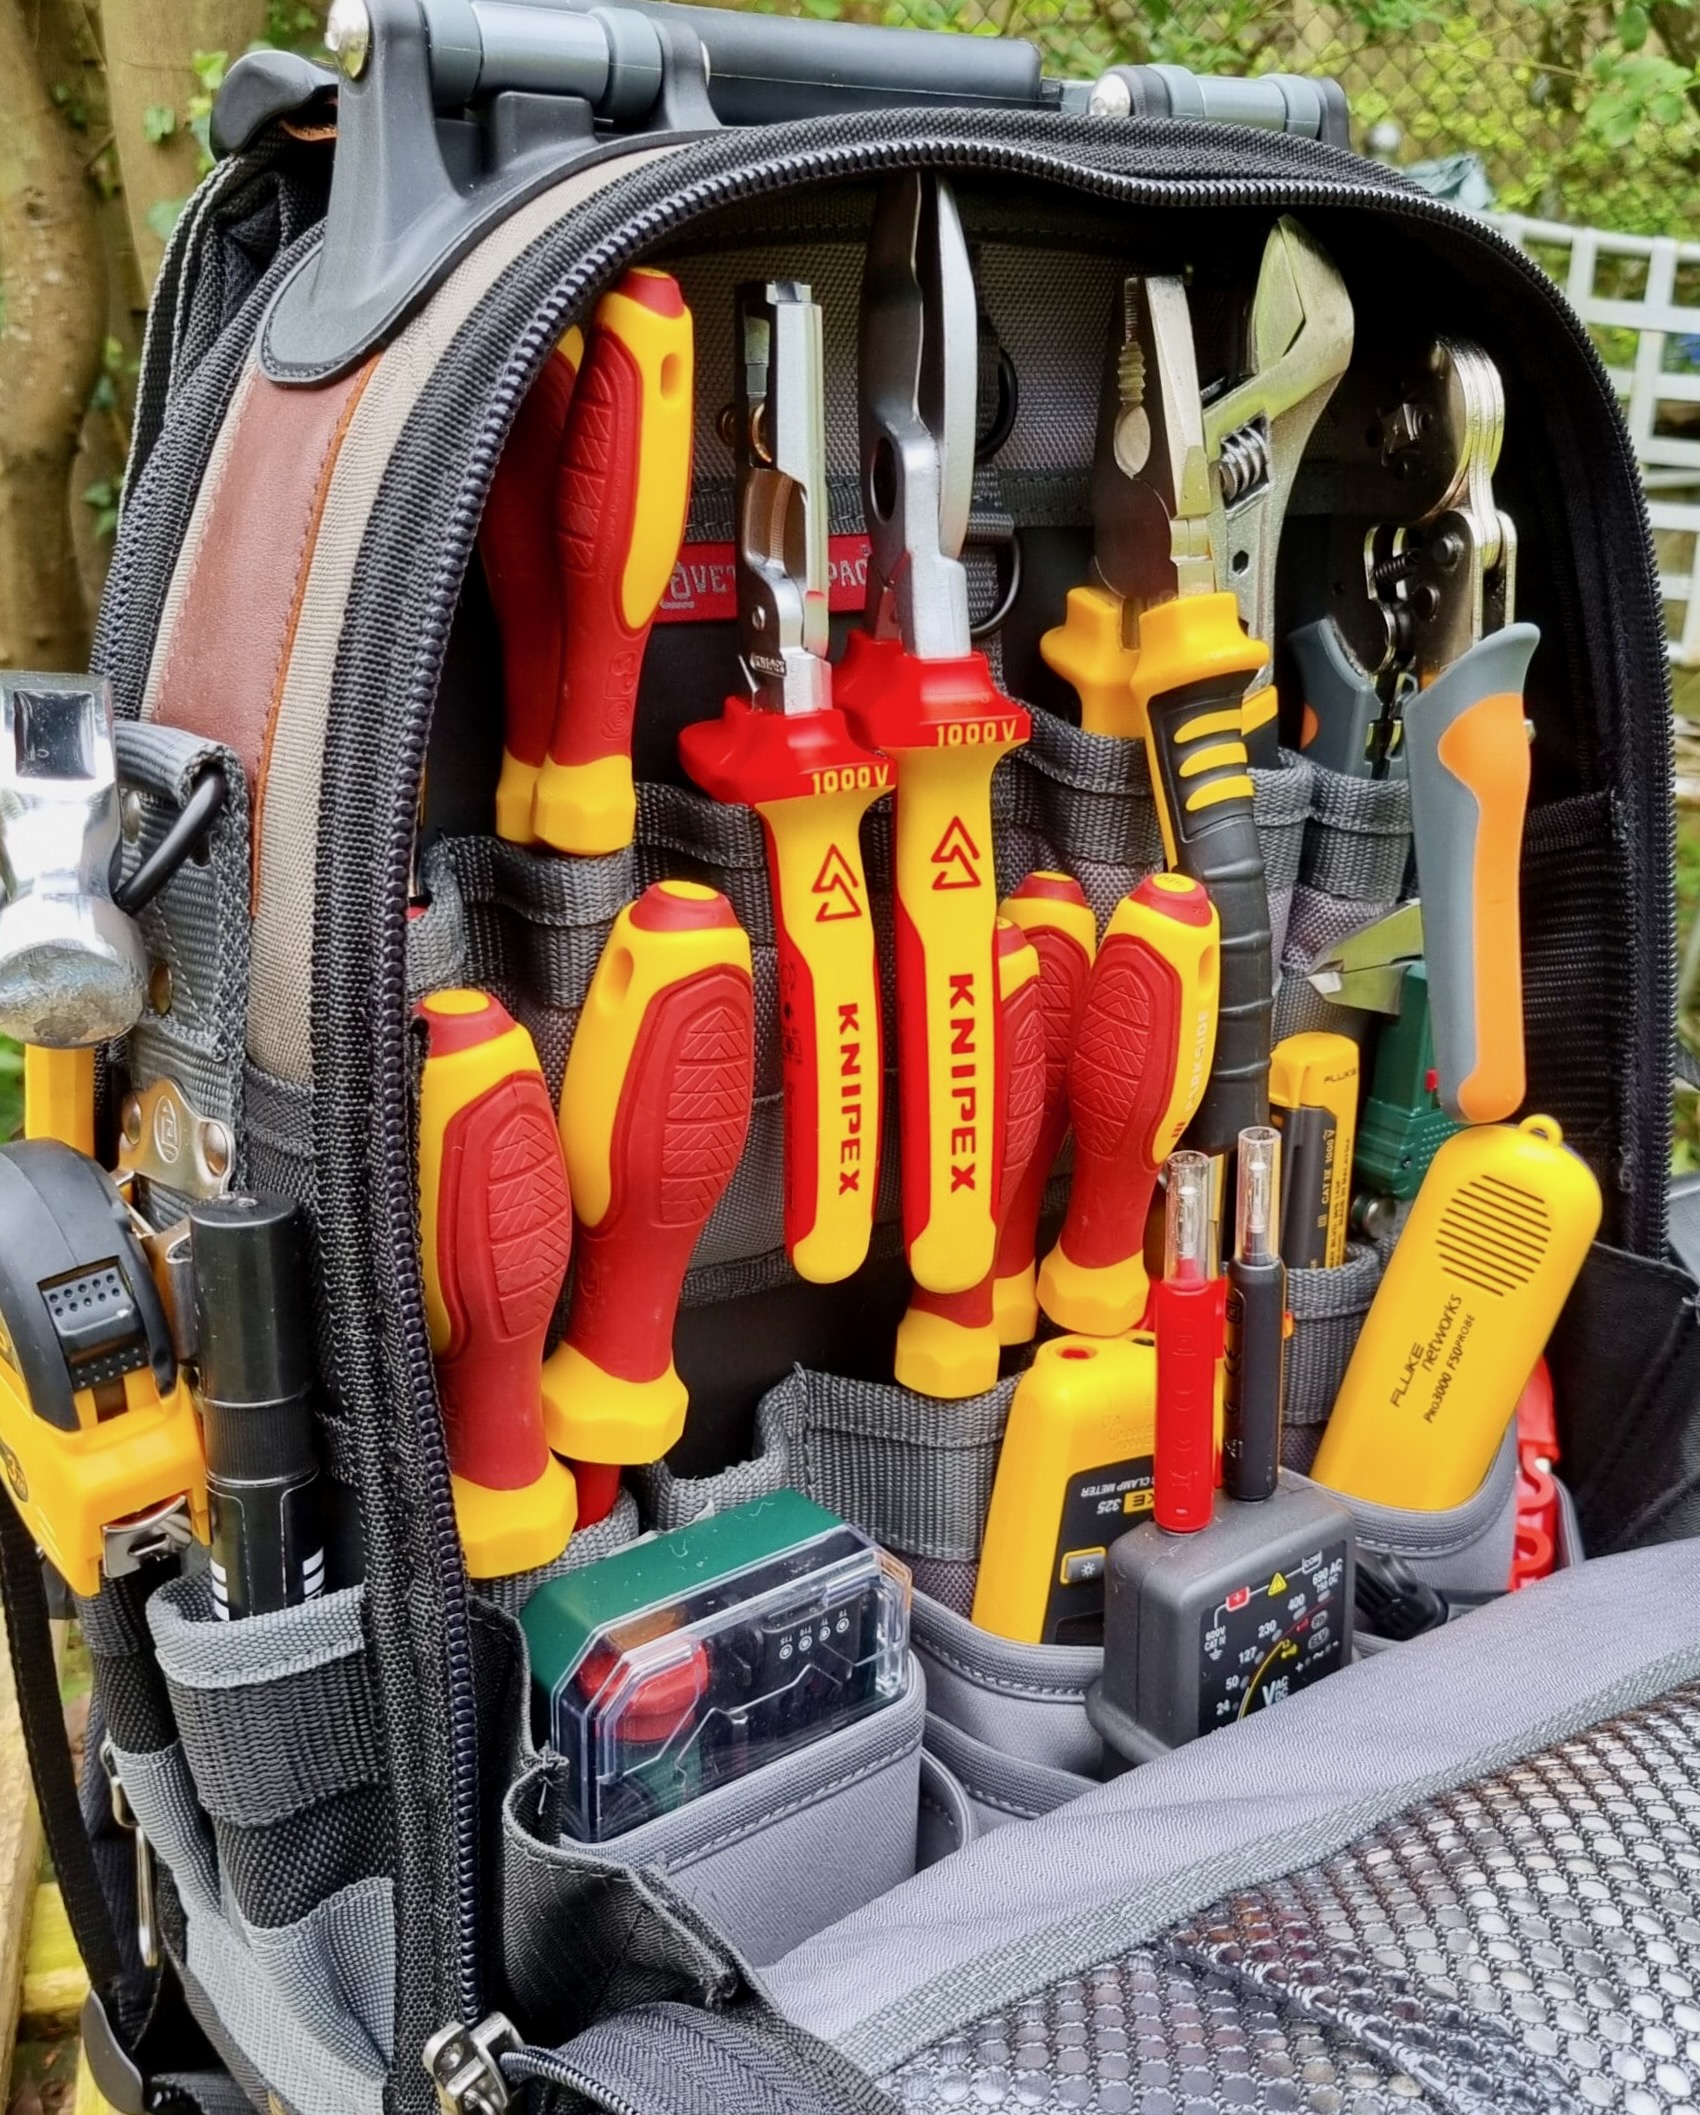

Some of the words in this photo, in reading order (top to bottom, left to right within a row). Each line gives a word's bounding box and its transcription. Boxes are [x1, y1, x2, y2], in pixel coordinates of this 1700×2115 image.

[1186, 1010, 1209, 1111] PARKSIDE
[949, 973, 976, 1194] KNIPEX
[838, 1003, 861, 1196] KNIPEX
[1321, 1181, 1333, 1205] CAT
[1421, 1293, 1462, 1372] networks
[1390, 1342, 1425, 1408] FLUKE
[1080, 1482, 1117, 1498] METER
[1117, 1476, 1150, 1492] CLAMP
[1096, 1497, 1122, 1515] 325
[1312, 1567, 1328, 1586] 690
[1329, 1557, 1344, 1576] AC
[1287, 1593, 1306, 1611] 400
[1257, 1619, 1276, 1639] 230
[1204, 1639, 1219, 1652] CAT
[1238, 1646, 1258, 1664] 127
[1225, 1674, 1240, 1692] 50
[1262, 1680, 1276, 1707] V
[1275, 1675, 1289, 1691] AC
[1216, 1699, 1230, 1716] 24
